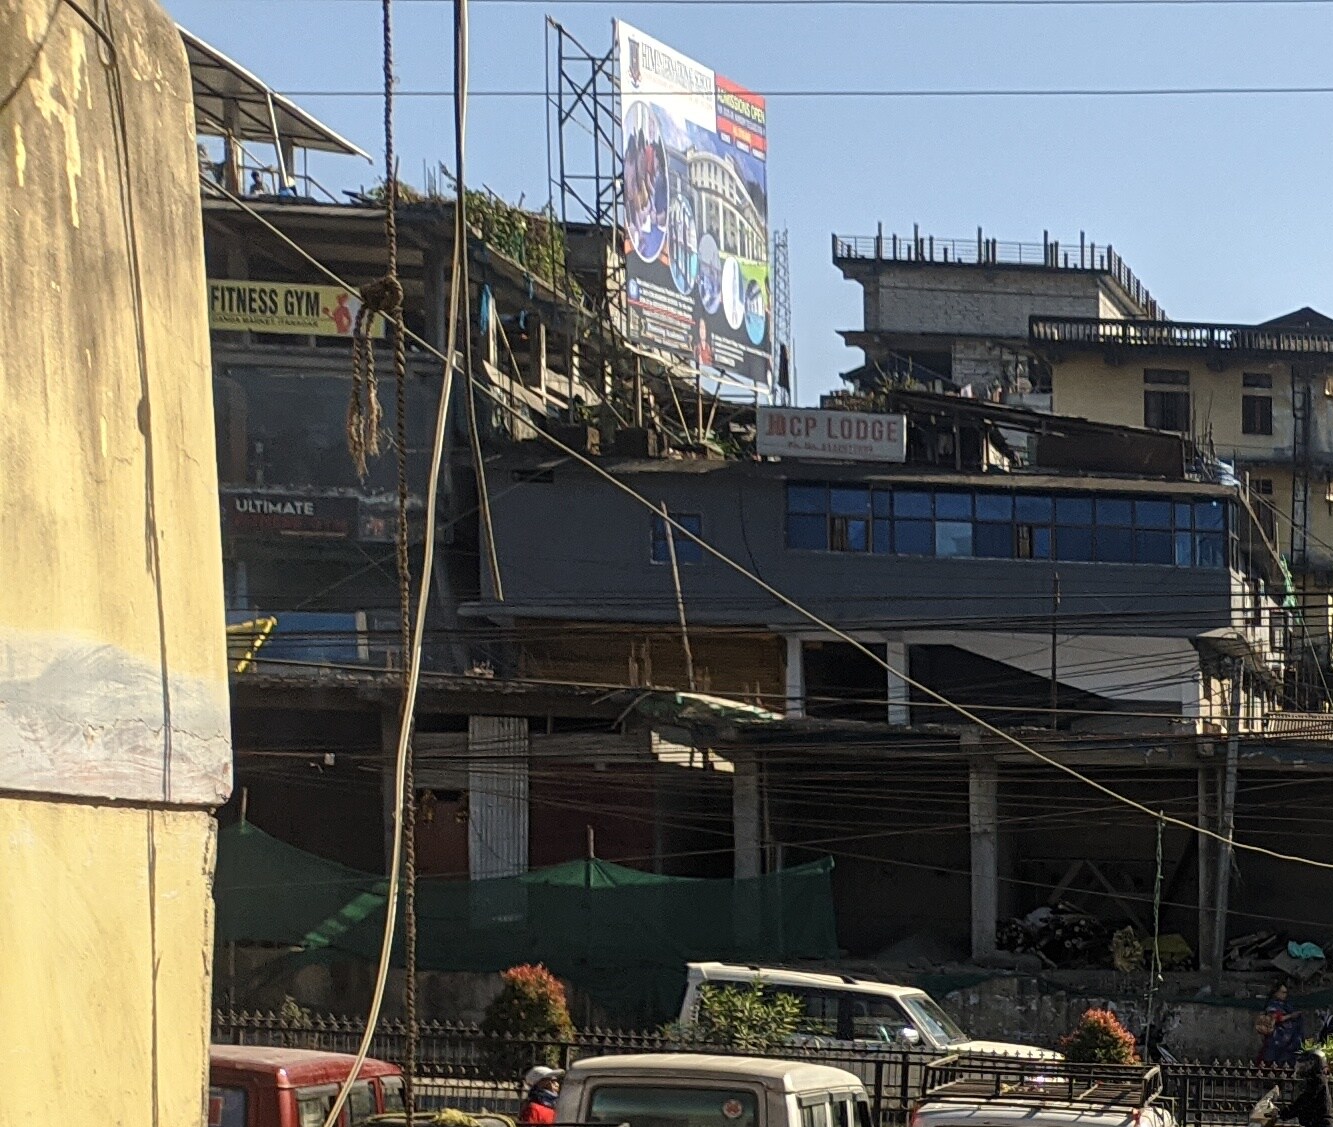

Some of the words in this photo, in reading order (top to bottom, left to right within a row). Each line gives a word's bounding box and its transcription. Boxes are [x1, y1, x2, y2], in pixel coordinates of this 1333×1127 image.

[210, 286, 278, 315] FITNESS
[284, 289, 320, 318] GYM
[827, 417, 898, 442] LODGE
[235, 499, 315, 517] ULTIMATE
